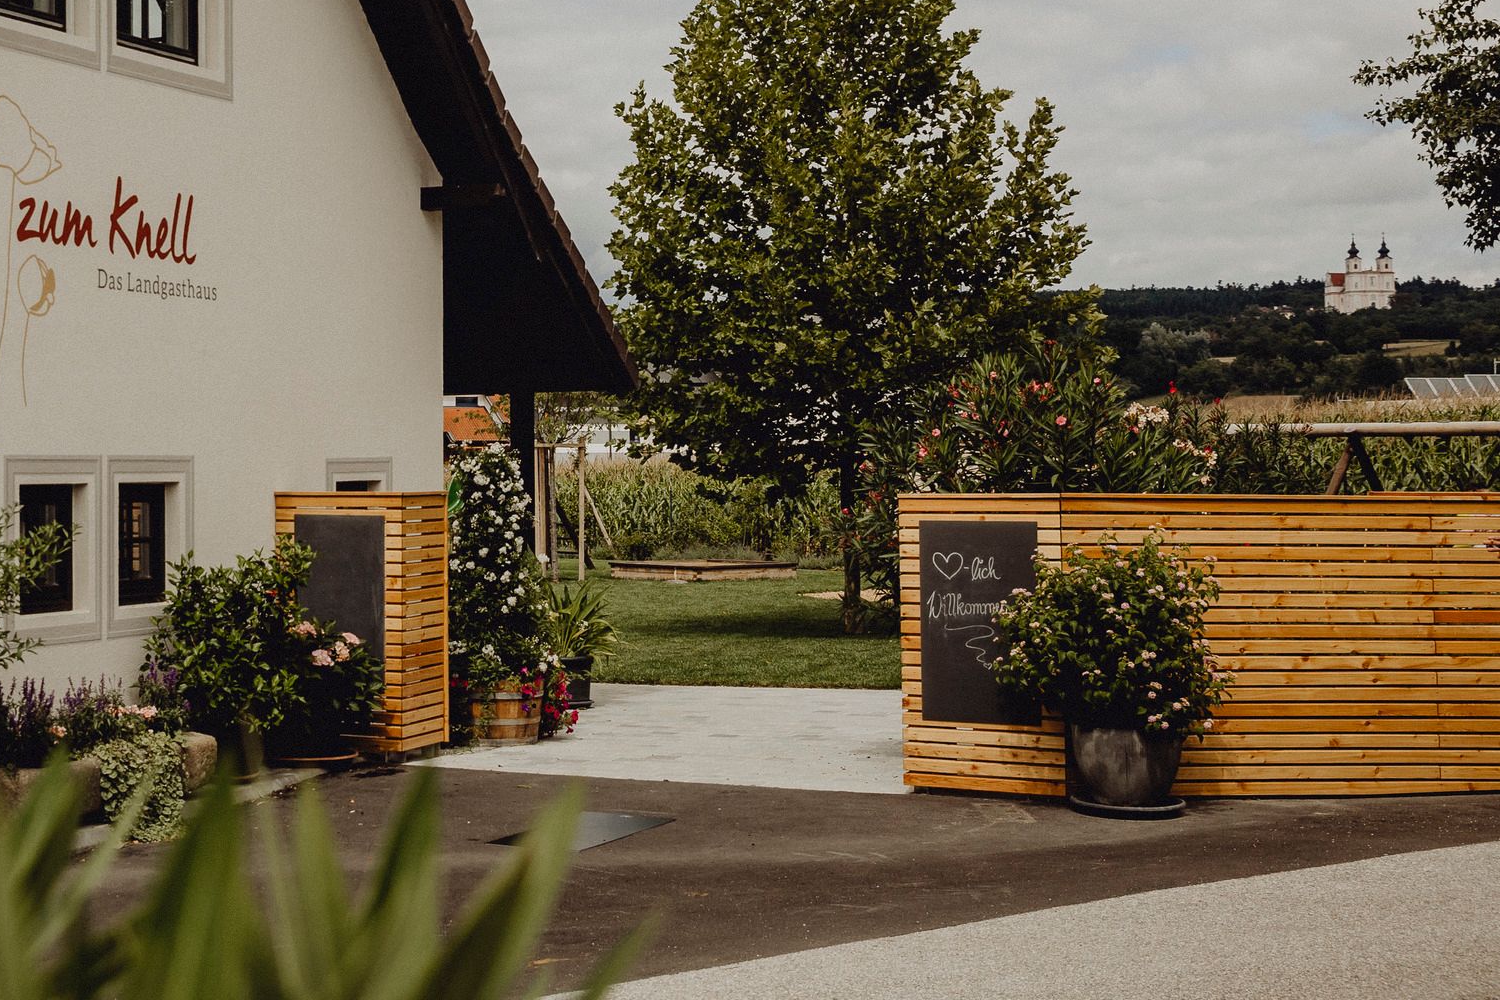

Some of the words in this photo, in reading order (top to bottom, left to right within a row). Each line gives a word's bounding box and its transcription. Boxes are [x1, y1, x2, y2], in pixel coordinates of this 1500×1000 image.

[16, 197, 98, 248] zum
[109, 176, 197, 265] Knell
[97, 268, 123, 291] Das
[127, 272, 218, 301] Landgasthaus
[926, 590, 1005, 619] Willkomme
